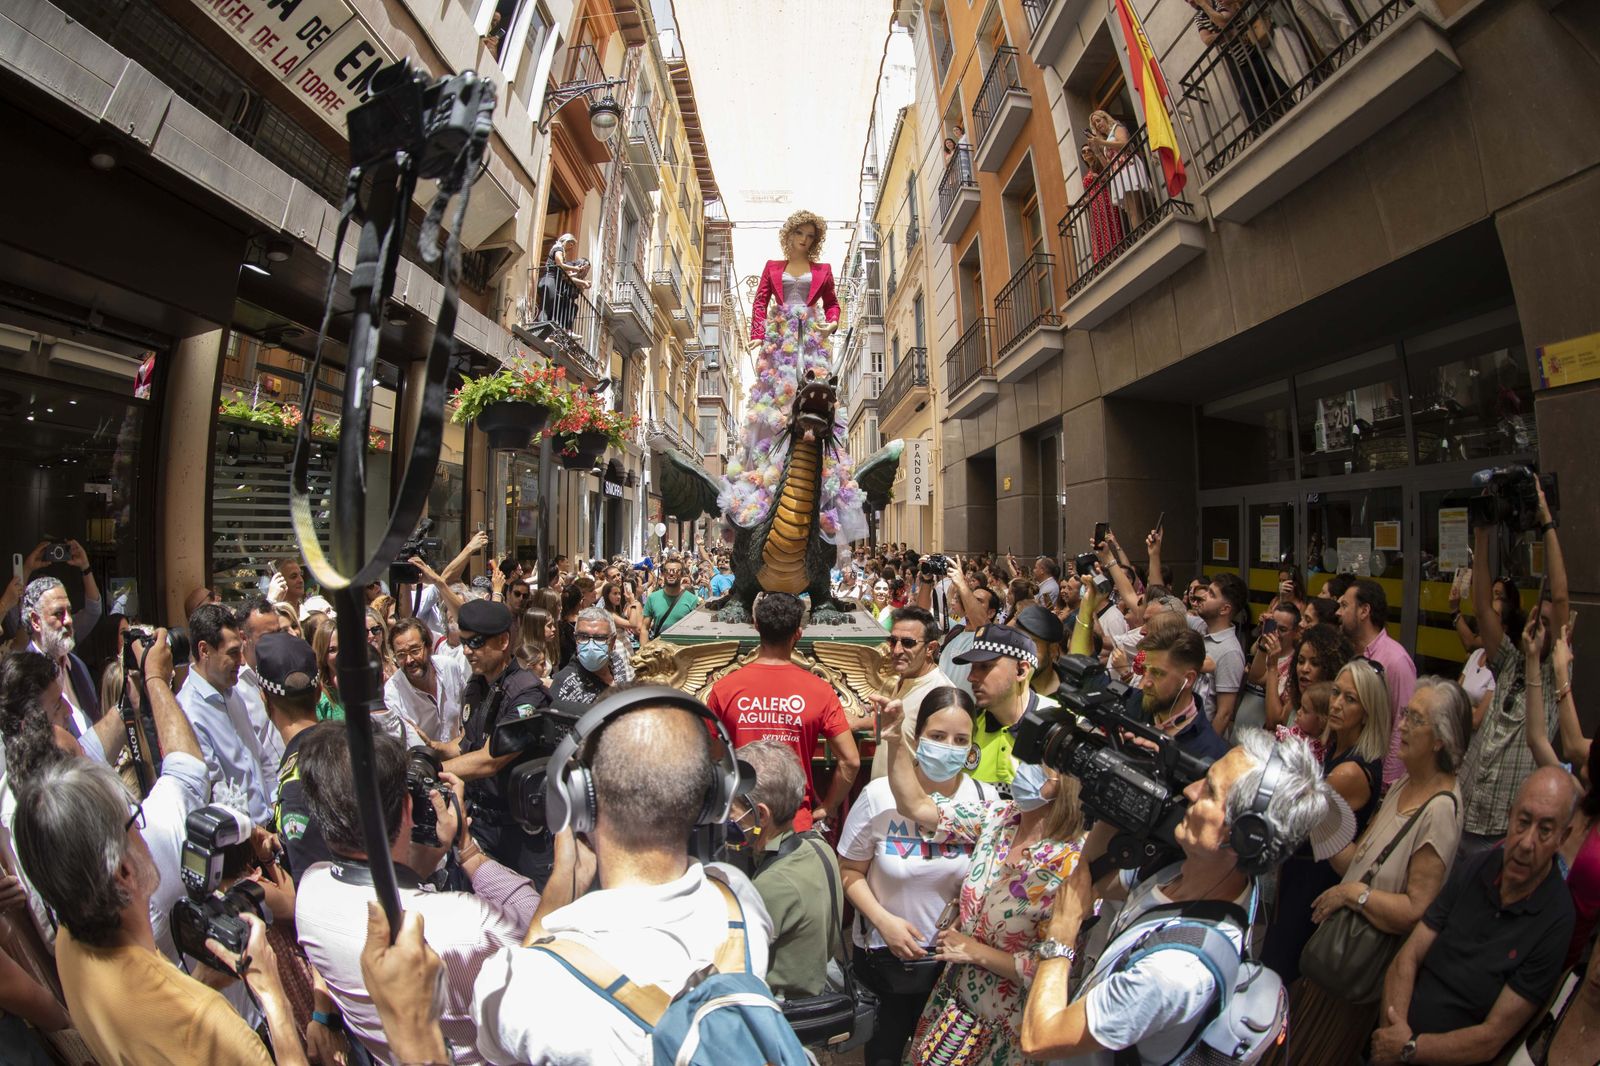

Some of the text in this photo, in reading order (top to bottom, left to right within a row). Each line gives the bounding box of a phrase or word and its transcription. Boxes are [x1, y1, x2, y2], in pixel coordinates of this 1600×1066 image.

[249, 25, 280, 54] DE
[270, 46, 300, 75] LA
[295, 67, 346, 117] TORRE
[296, 16, 332, 50] DE
[333, 39, 384, 104] EM
[914, 443, 922, 501] PANDORA
[737, 694, 806, 714] CALERO
[738, 712, 804, 727] AGUILERA
[128, 727, 142, 762] SONY
[761, 732, 801, 743] servicios
